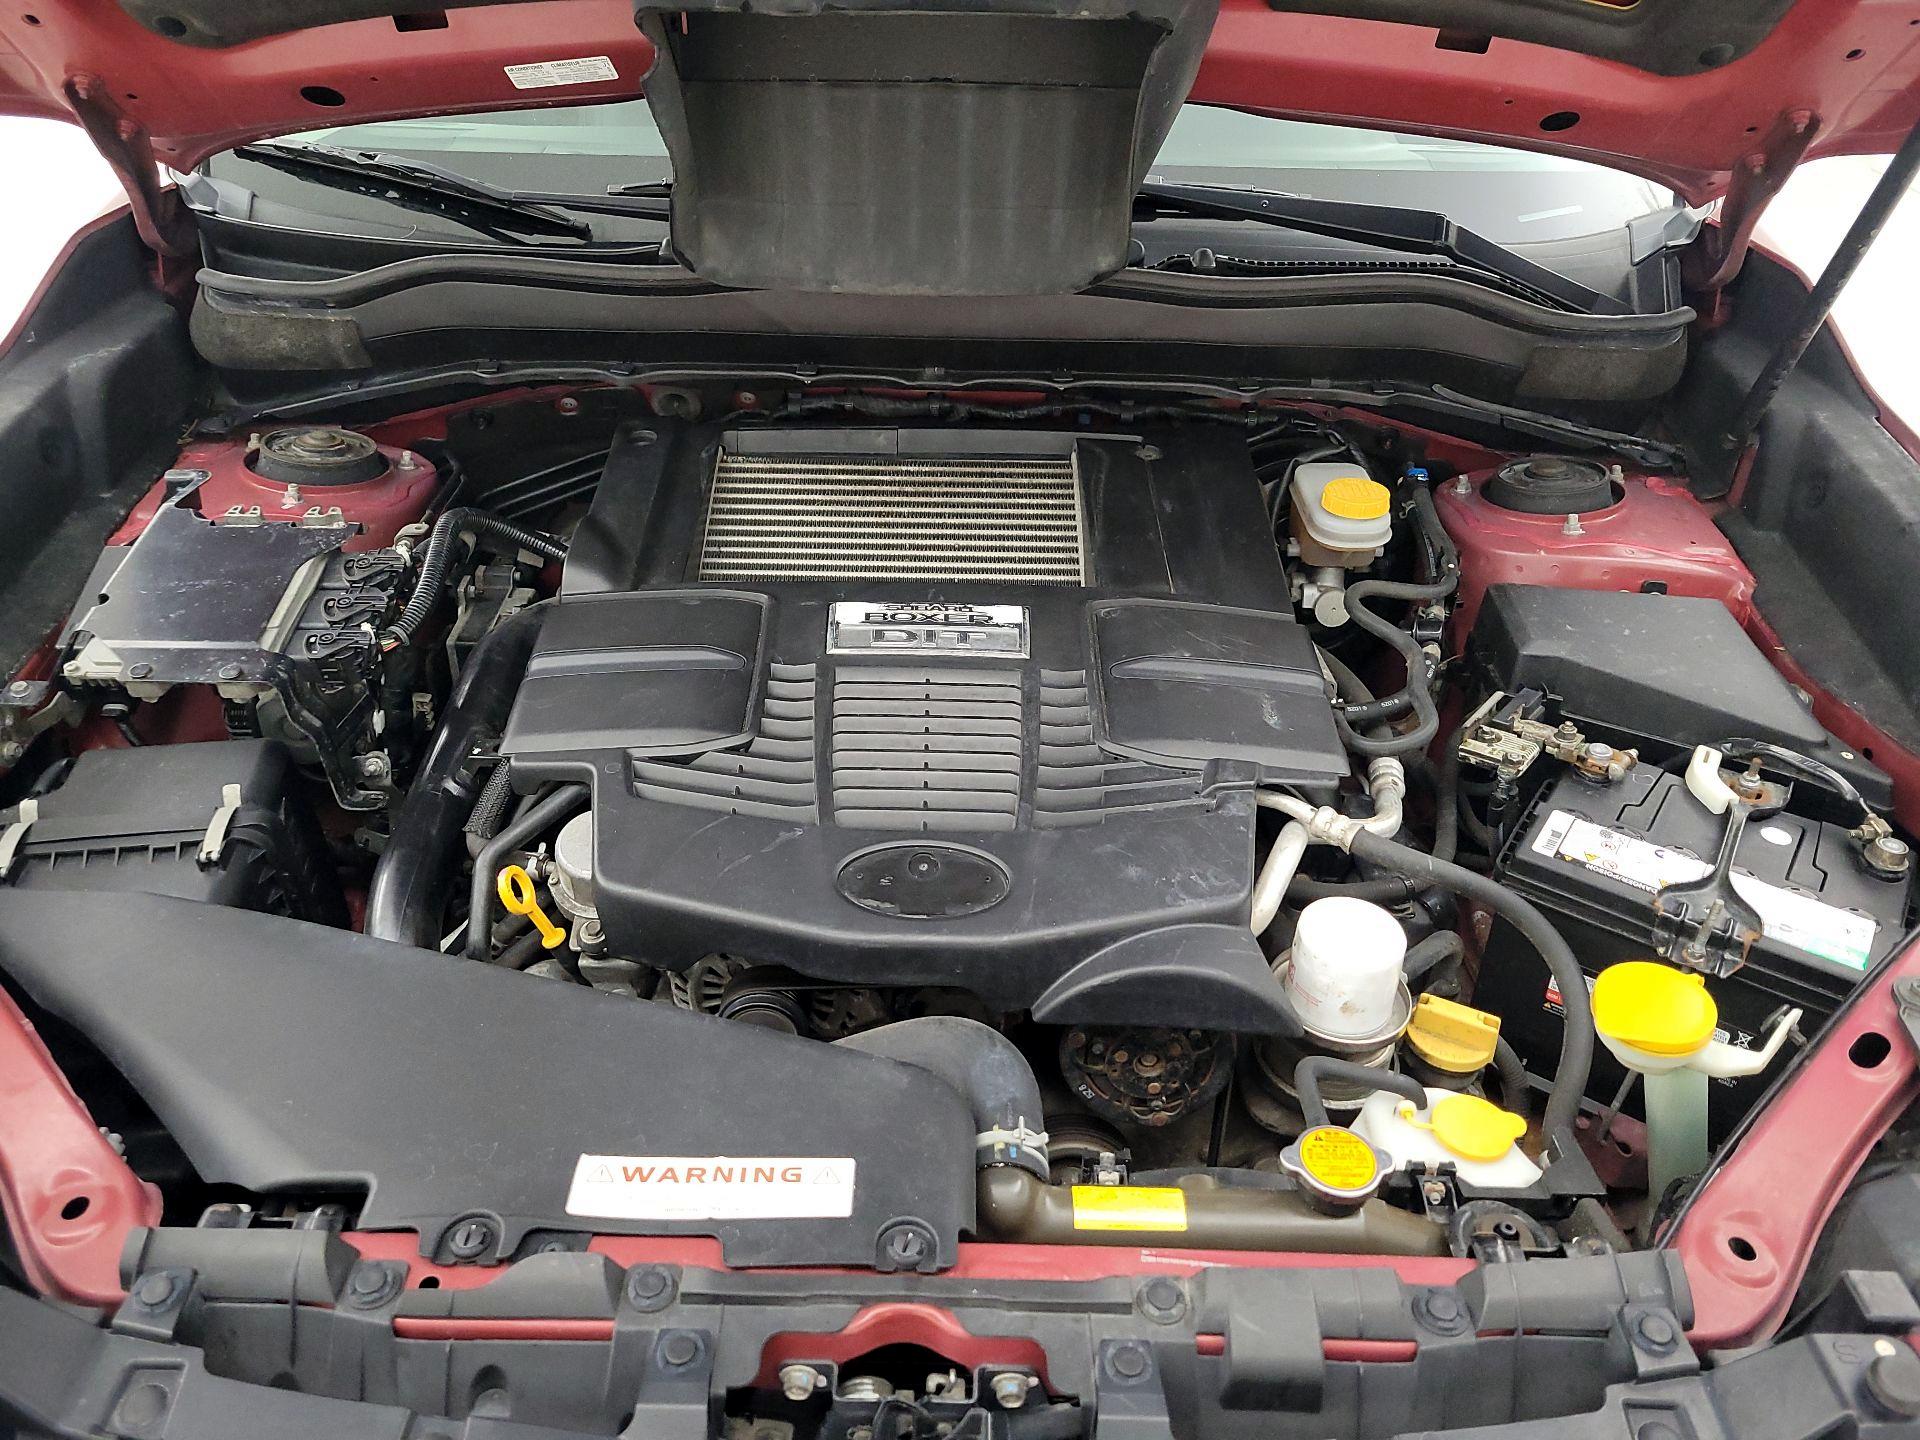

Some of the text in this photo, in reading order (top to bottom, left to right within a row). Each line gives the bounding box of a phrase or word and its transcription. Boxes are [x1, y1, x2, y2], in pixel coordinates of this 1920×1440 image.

[864, 612, 994, 625] BOXER
[870, 629, 988, 648] DIT
[621, 1165, 803, 1184] WARNING
